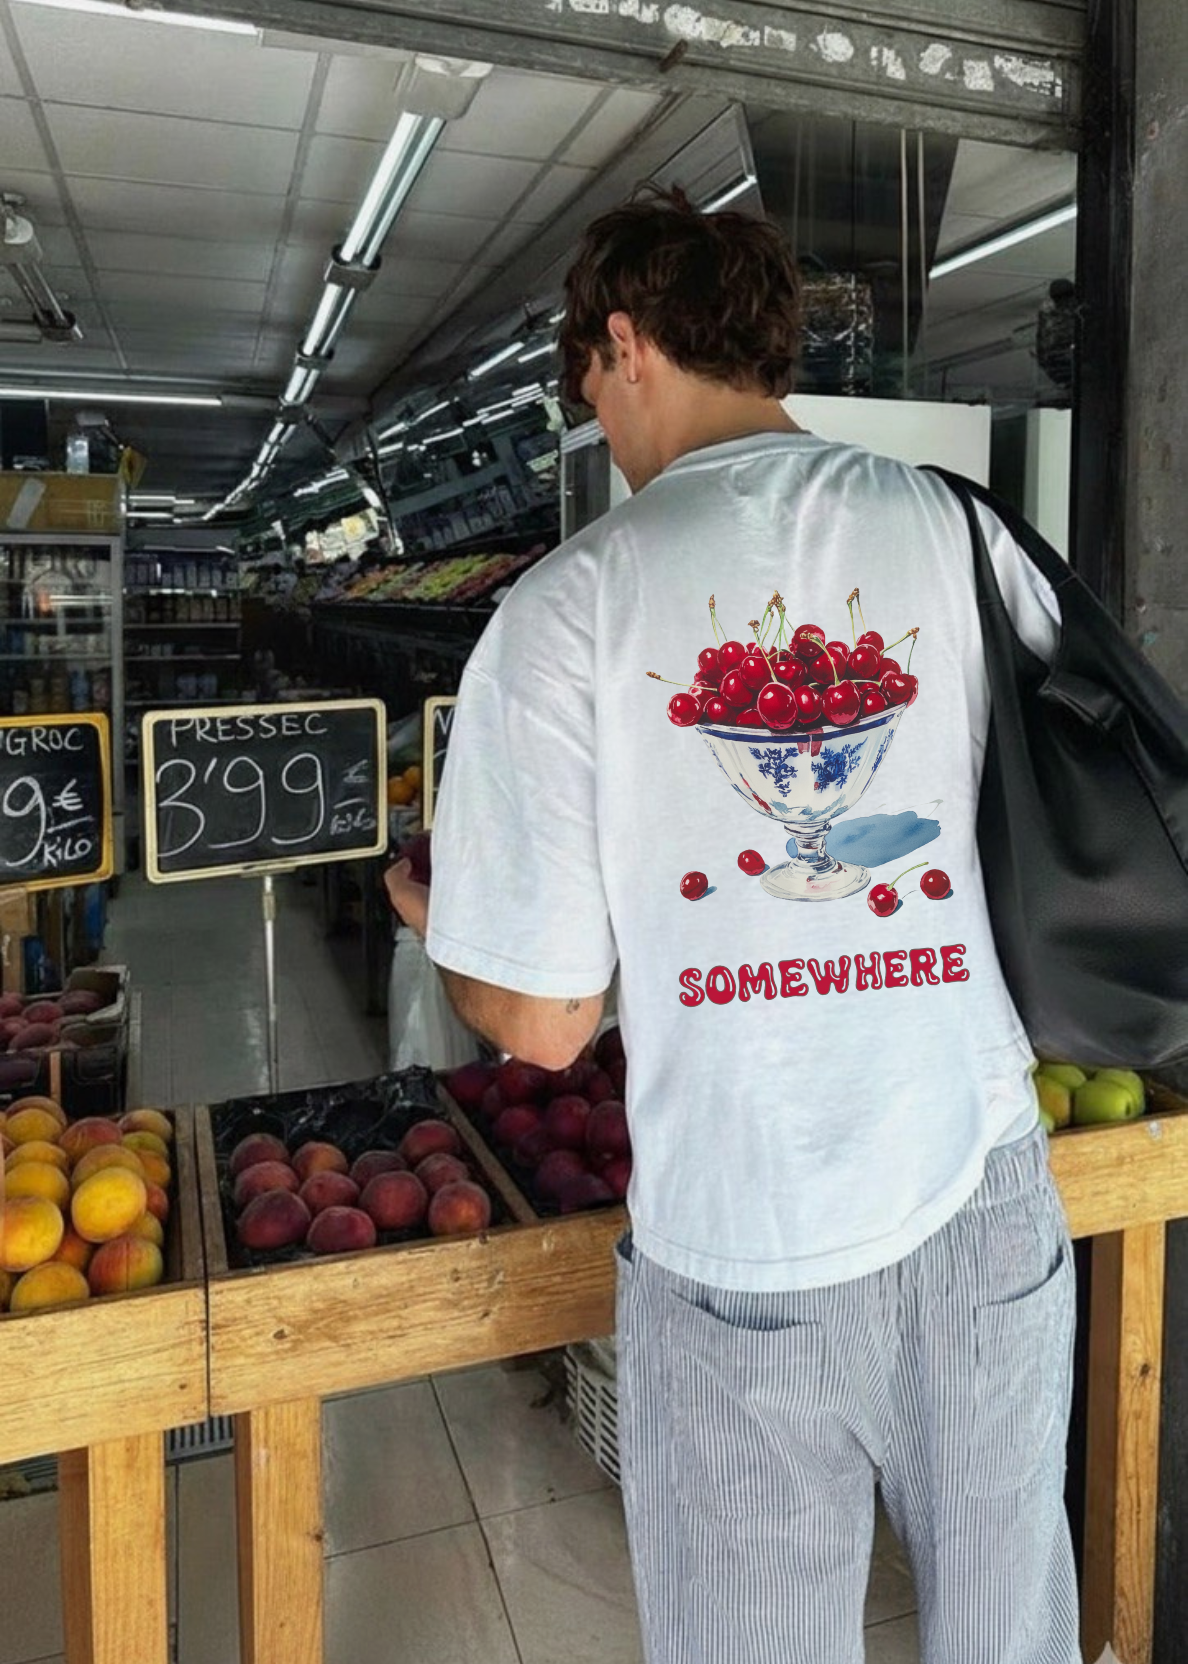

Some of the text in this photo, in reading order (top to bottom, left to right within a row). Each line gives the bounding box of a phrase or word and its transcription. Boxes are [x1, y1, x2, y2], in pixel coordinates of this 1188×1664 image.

[170, 712, 328, 747] PRESSEC
[52, 778, 83, 811] €
[155, 752, 325, 857] 3'99
[679, 943, 970, 1007] SOMEWHERE
